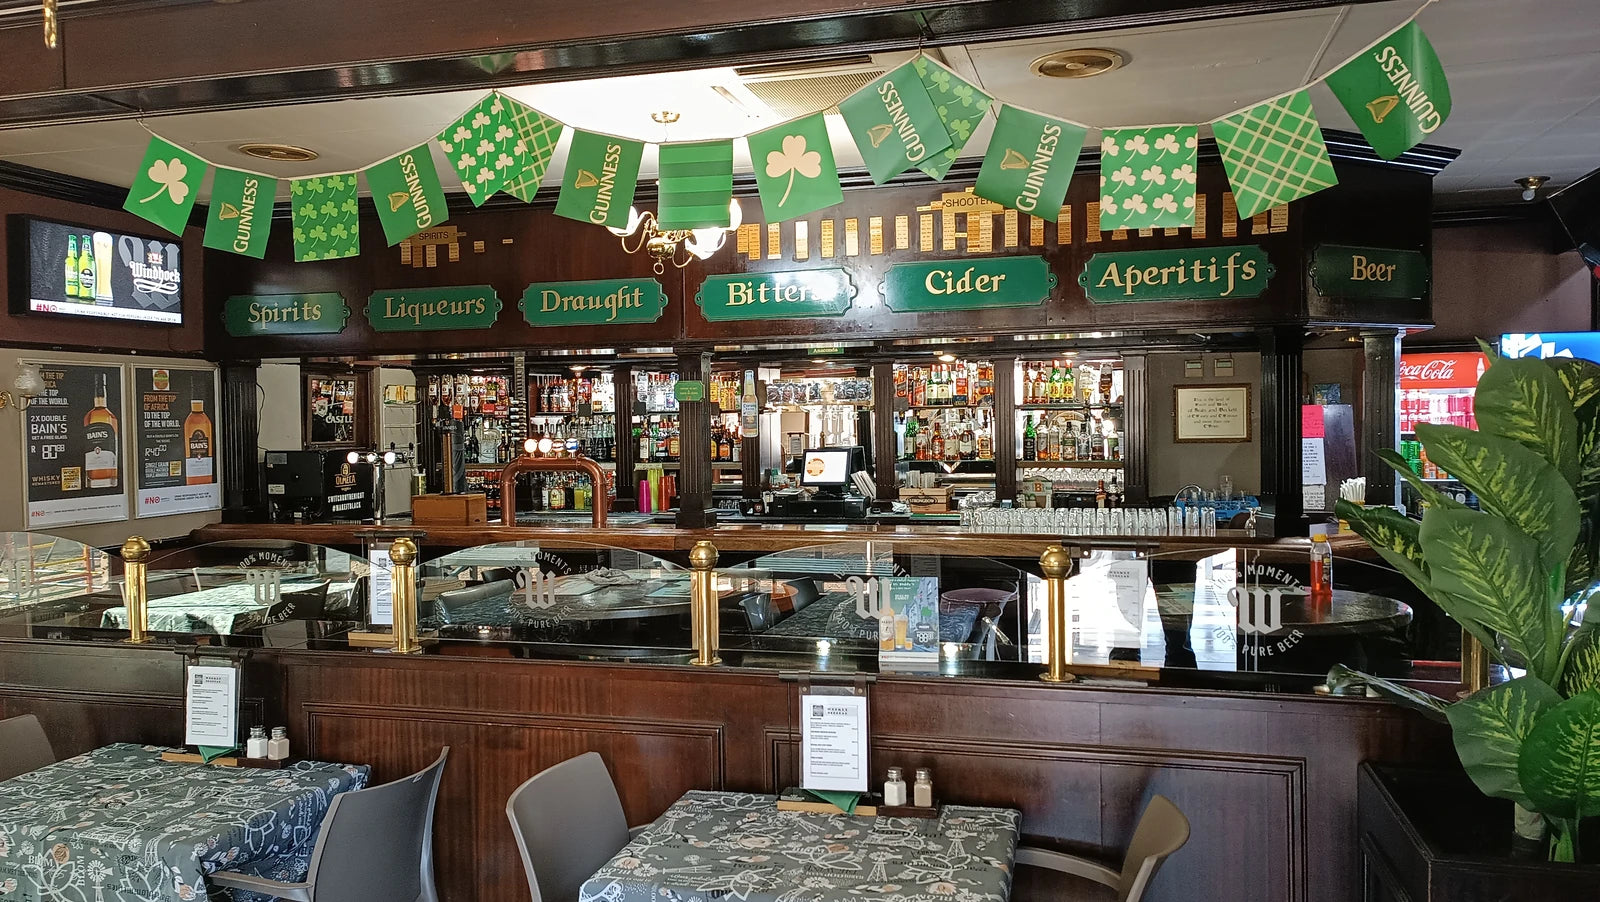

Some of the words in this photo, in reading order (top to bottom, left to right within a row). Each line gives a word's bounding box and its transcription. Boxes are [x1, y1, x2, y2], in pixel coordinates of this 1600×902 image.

[1375, 46, 1441, 134] GUINNESS
[877, 80, 926, 162] GUINNESS
[1015, 124, 1062, 212] GUINNESS
[399, 154, 432, 229] GUINNESS
[589, 143, 622, 224] GUINNESS
[233, 178, 258, 253] GUINNESS
[420, 231, 449, 241] SPIRITS
[129, 260, 181, 285] Windhoek
[924, 266, 1006, 295] Cider
[1095, 251, 1257, 296] Aperitifs
[1350, 254, 1397, 282] Beer
[247, 301, 322, 330] Spirits
[382, 295, 486, 325] Liqueurs
[540, 285, 645, 321] Draught
[31, 423, 68, 434] BAIN'S
[144, 411, 151, 420] TO
[151, 411, 160, 419] THE
[161, 411, 171, 419] TOP
[144, 420, 151, 428] OF
[326, 415, 354, 424] CASTLE
[31, 445, 36, 453] R
[86, 431, 109, 440] BAIN'S
[335, 474, 357, 485] OLMECA
[278, 602, 296, 621] BEER
[527, 619, 551, 628] PURE
[552, 605, 574, 624] BEER
[859, 629, 880, 640] PUR
[1241, 645, 1275, 657] PURE
[1277, 629, 1305, 653] BEER
